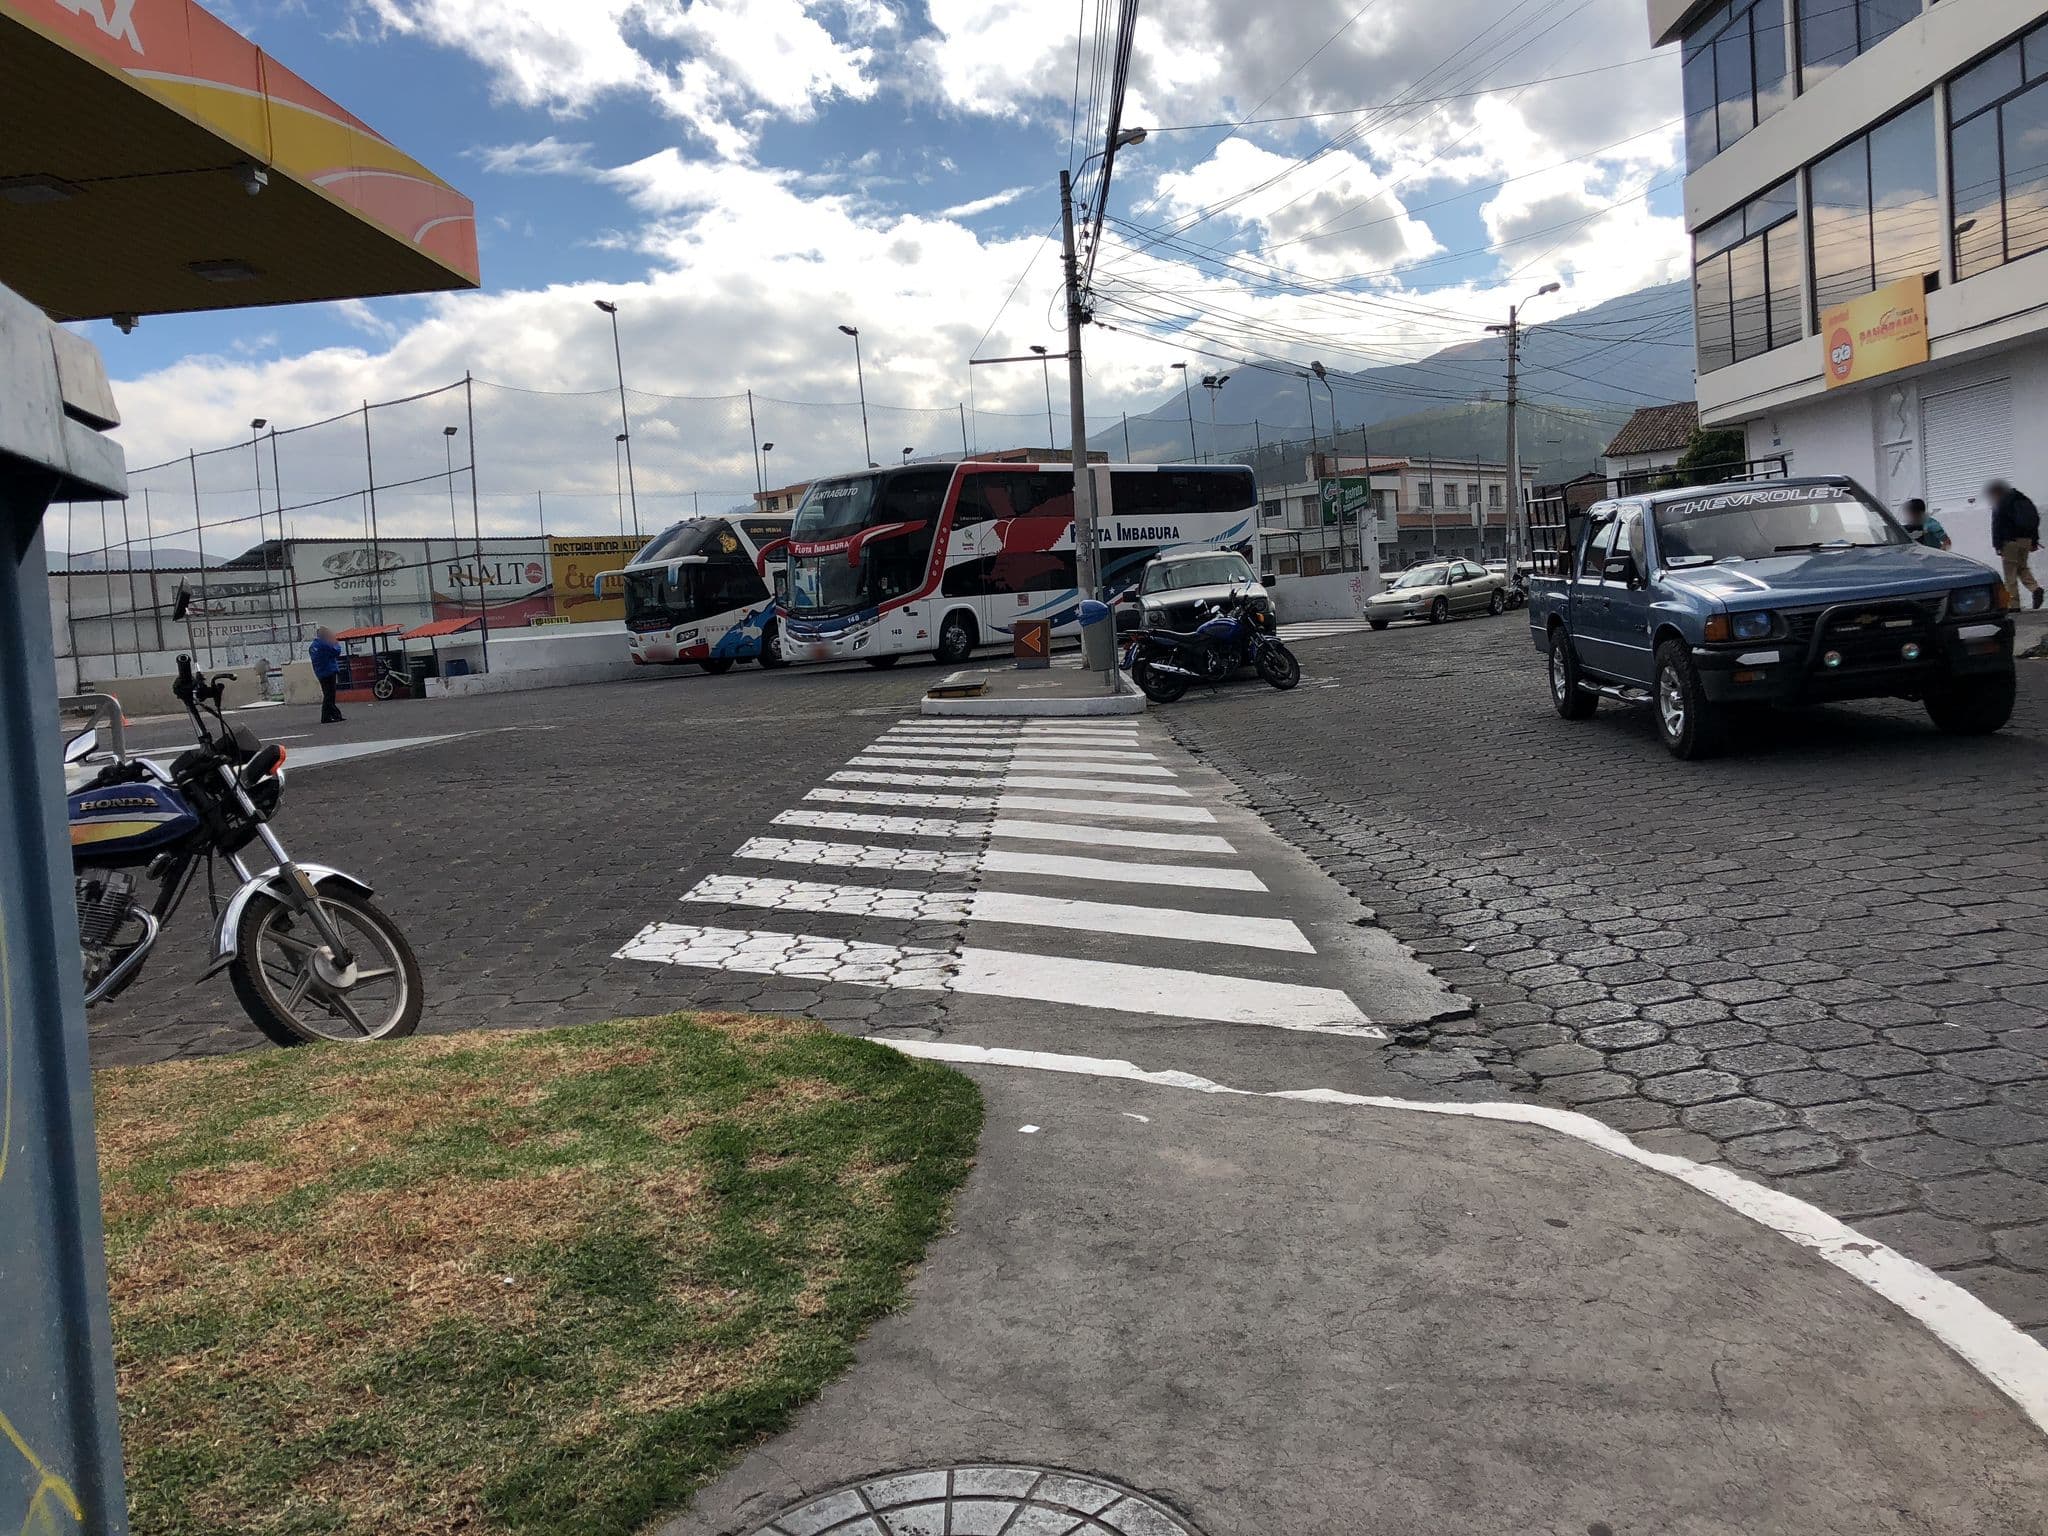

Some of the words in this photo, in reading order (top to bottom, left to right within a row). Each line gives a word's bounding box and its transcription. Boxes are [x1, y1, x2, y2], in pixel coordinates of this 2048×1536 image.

[1666, 487, 1850, 513] CHEVROLET
[1116, 522, 1180, 541] IMBABURA
[814, 540, 850, 553] IMBABURA
[80, 798, 158, 811] HONDA
